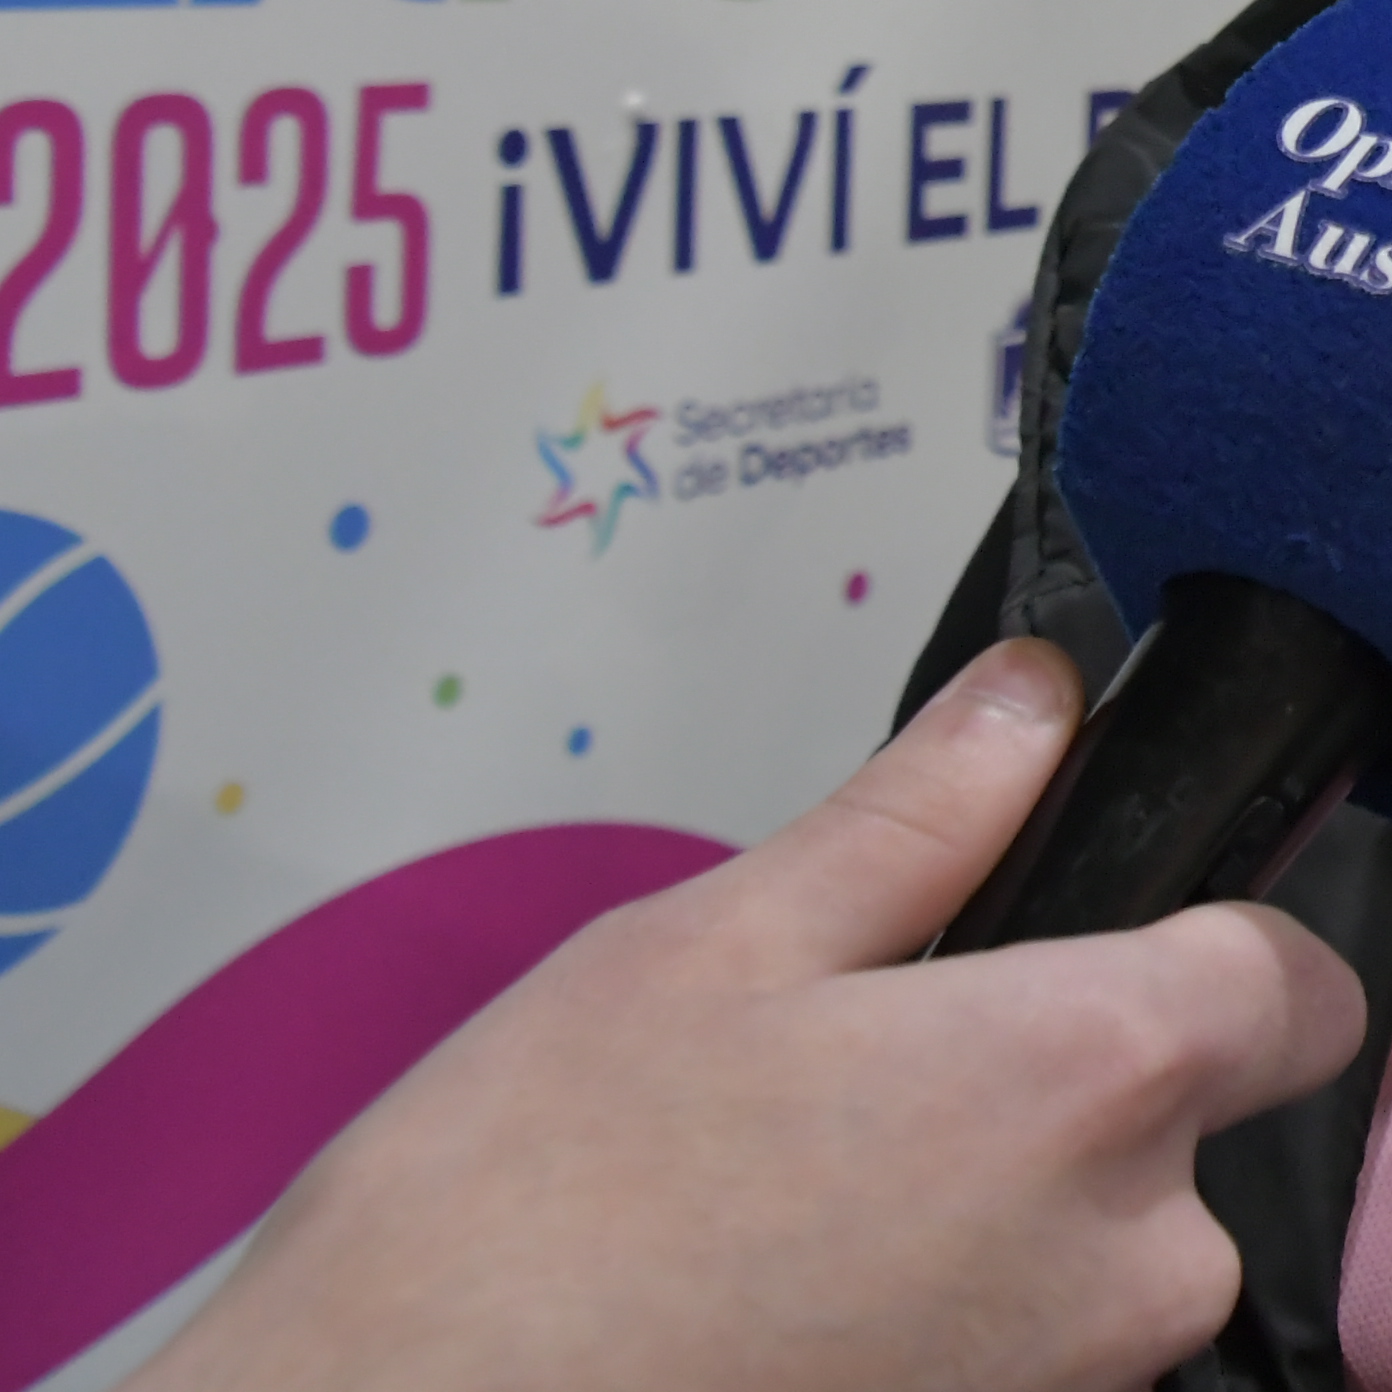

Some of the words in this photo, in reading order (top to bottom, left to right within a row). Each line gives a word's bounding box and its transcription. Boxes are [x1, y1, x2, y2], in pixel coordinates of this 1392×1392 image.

[0, 83, 430, 406] 2025
[906, 94, 1041, 247] EL
[673, 459, 730, 501] de
[739, 420, 913, 488] Deportes
